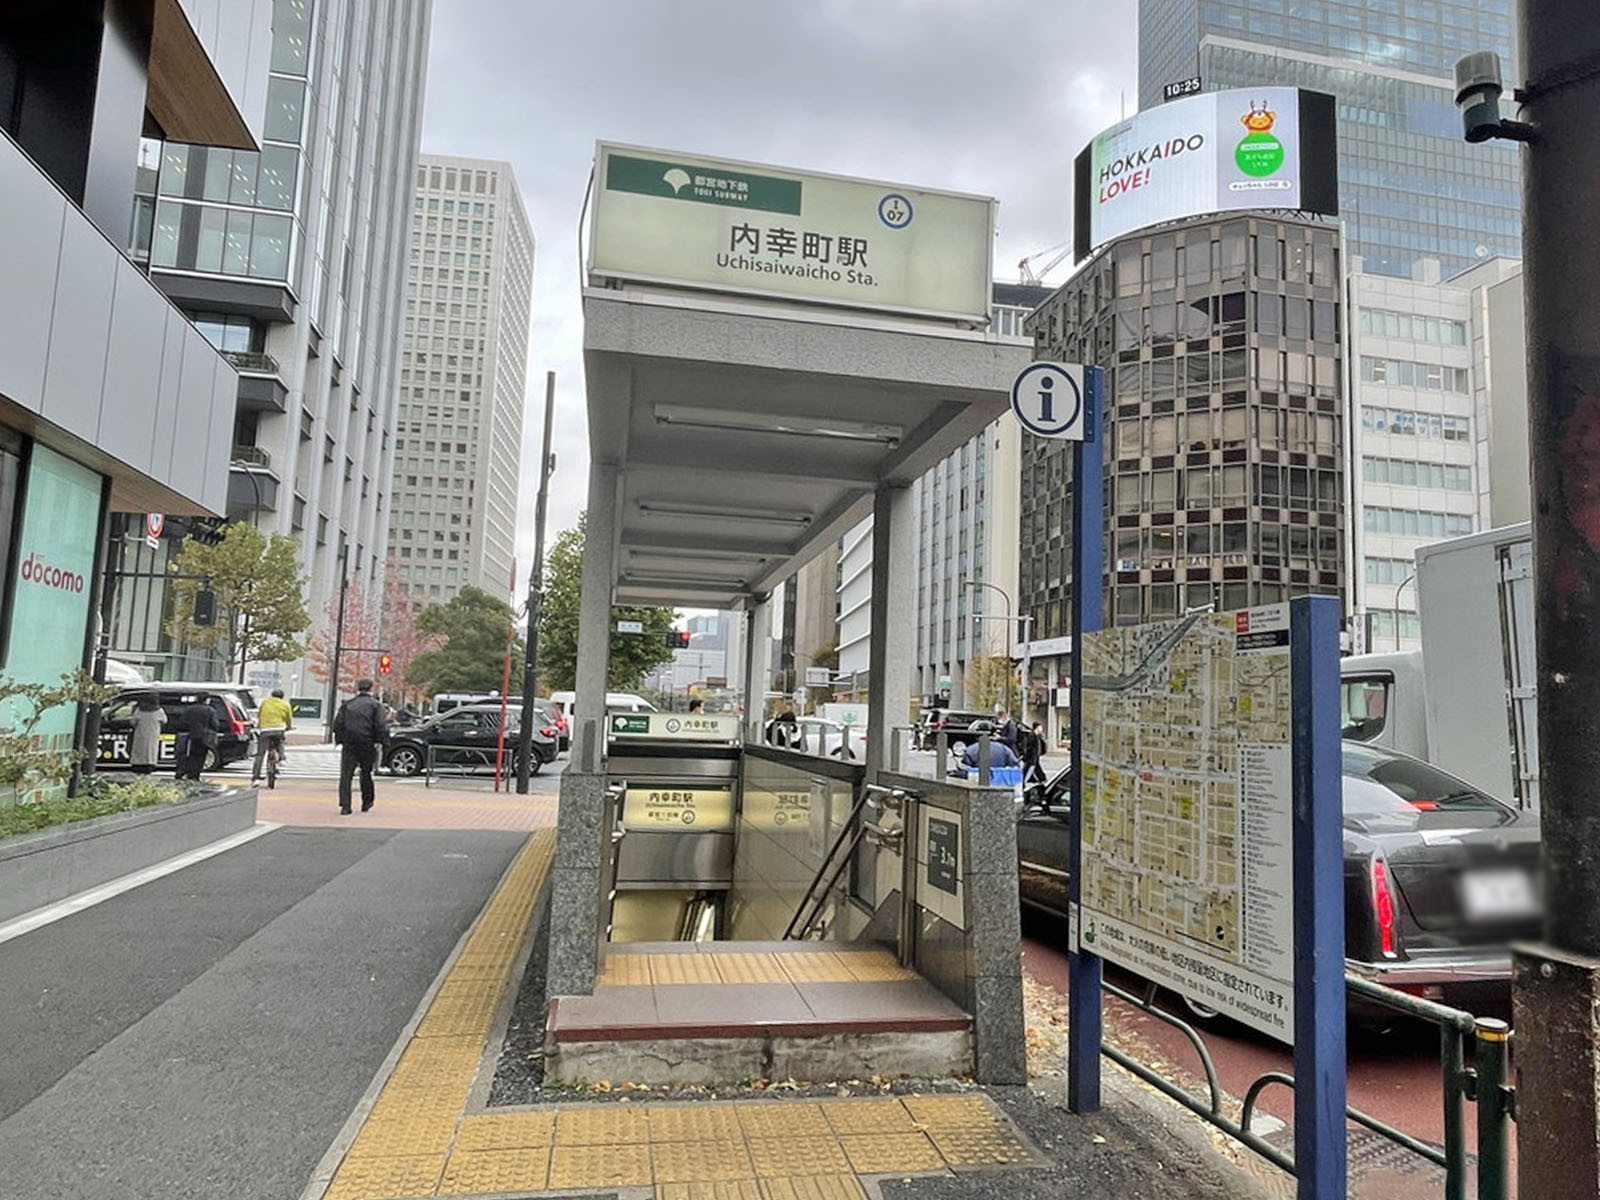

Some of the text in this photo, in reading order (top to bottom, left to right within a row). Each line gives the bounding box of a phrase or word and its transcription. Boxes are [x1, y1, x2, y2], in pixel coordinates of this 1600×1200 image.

[1166, 79, 1201, 97] 10:25
[1099, 134, 1204, 184] HOKKAIDO
[1099, 168, 1152, 204] LOVE!
[887, 210, 904, 221] 07
[730, 222, 869, 268] 内幸町駅
[716, 253, 879, 287] Uchisaiwaicho Sta.
[22, 552, 83, 593] docomo
[649, 792, 693, 803] 内幸町駅
[1216, 991, 1228, 1003] risk
[1235, 1001, 1273, 1023] widespread
